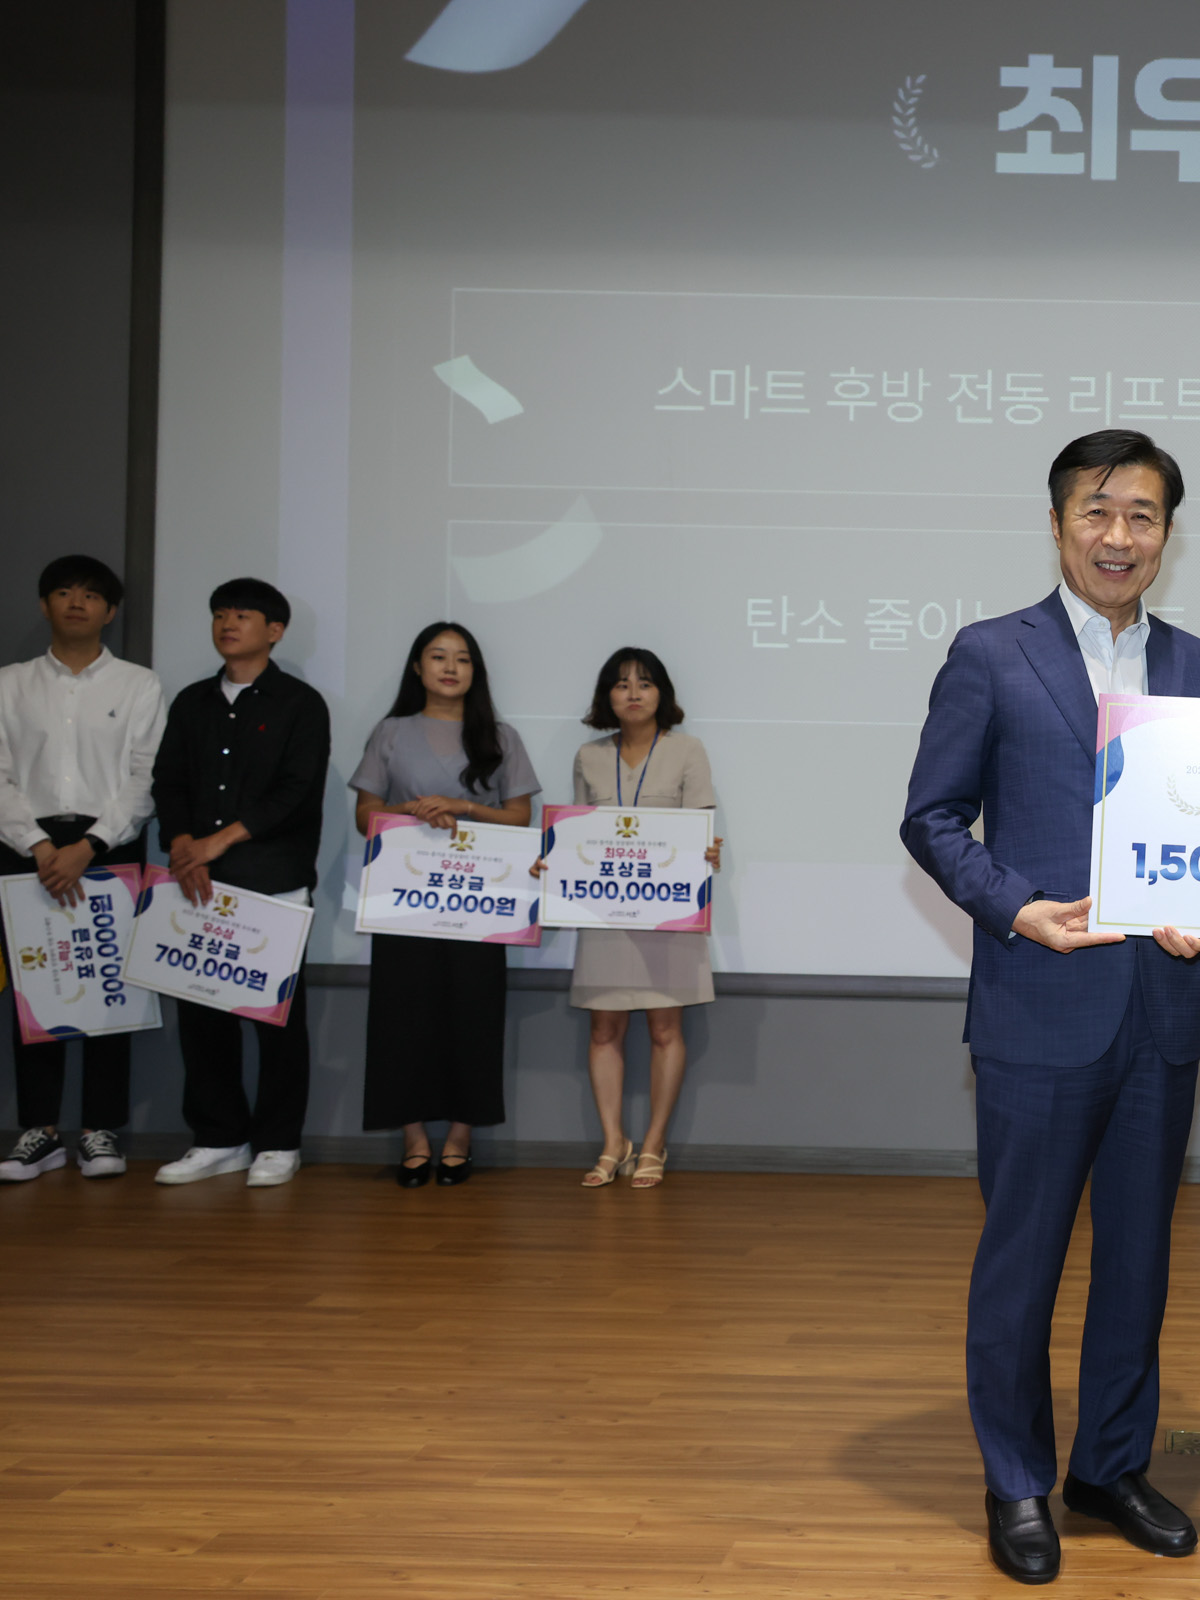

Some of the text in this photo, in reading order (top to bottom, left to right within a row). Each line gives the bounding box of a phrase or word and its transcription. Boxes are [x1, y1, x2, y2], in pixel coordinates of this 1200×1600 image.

[654, 366, 811, 420] 스마트
[827, 366, 931, 424] 후방
[946, 369, 1051, 425] 전동
[745, 596, 847, 650] 탄소
[441, 859, 475, 873] 우수상
[605, 847, 647, 860] 최우수상
[427, 872, 484, 891] 포상금
[599, 861, 652, 879] 포상금
[392, 888, 516, 917] 700,000원
[559, 879, 691, 902] 1,500,000원
[202, 922, 234, 940] 우수상
[72, 928, 95, 980] 포상금
[89, 893, 127, 1007] 300,000원
[188, 933, 241, 960] 포상금
[155, 943, 268, 992] 700,000원
